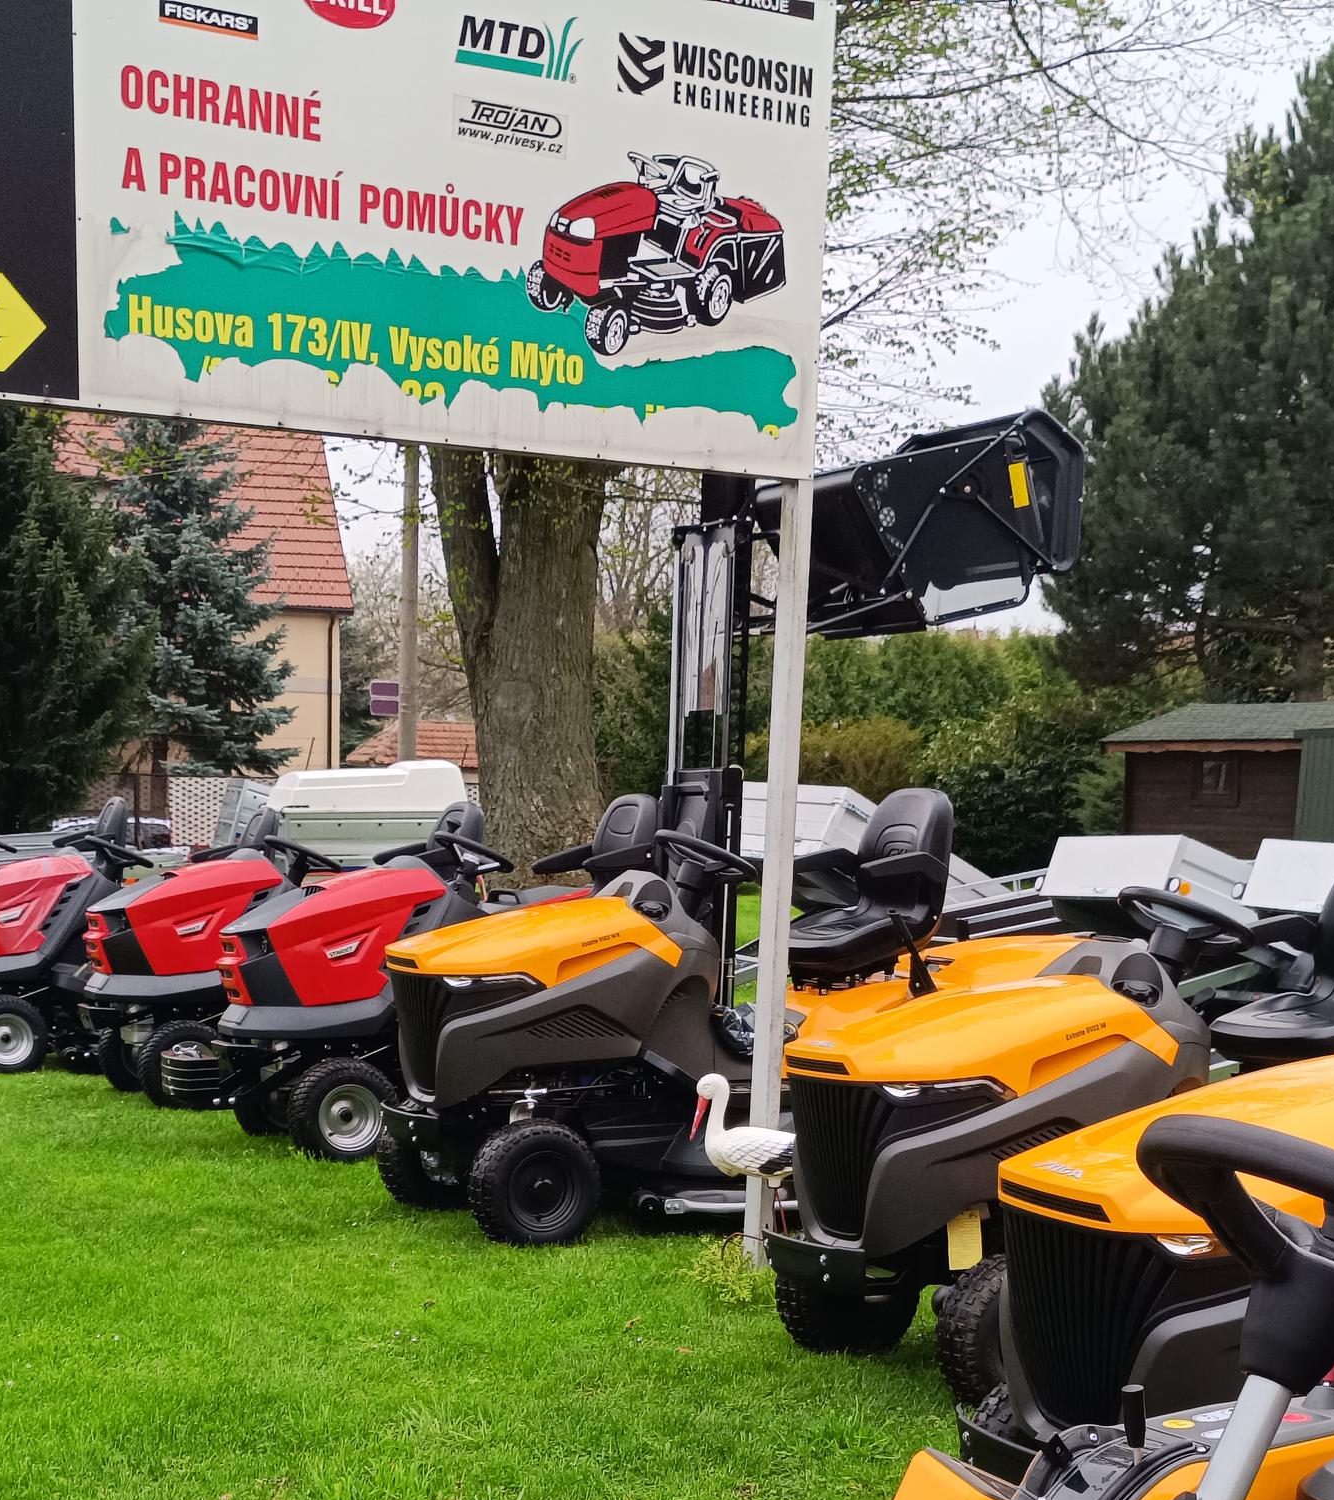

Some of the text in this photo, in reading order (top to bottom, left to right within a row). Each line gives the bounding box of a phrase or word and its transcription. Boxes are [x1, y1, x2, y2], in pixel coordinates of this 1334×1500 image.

[164, 3, 250, 31] FISKARS
[458, 15, 546, 60] MTD
[672, 41, 814, 98] WISCONSIN
[121, 65, 321, 142] OCHRANNÉ
[673, 81, 811, 127] ENGINEERING
[457, 126, 563, 154] www.privesy.cz
[122, 147, 524, 246] A PRACOVNÍ POMŮCKY
[128, 294, 254, 348] Husova
[267, 312, 379, 367] 173/IV,
[389, 326, 500, 375] Vysoké
[510, 340, 585, 386] Mýto
